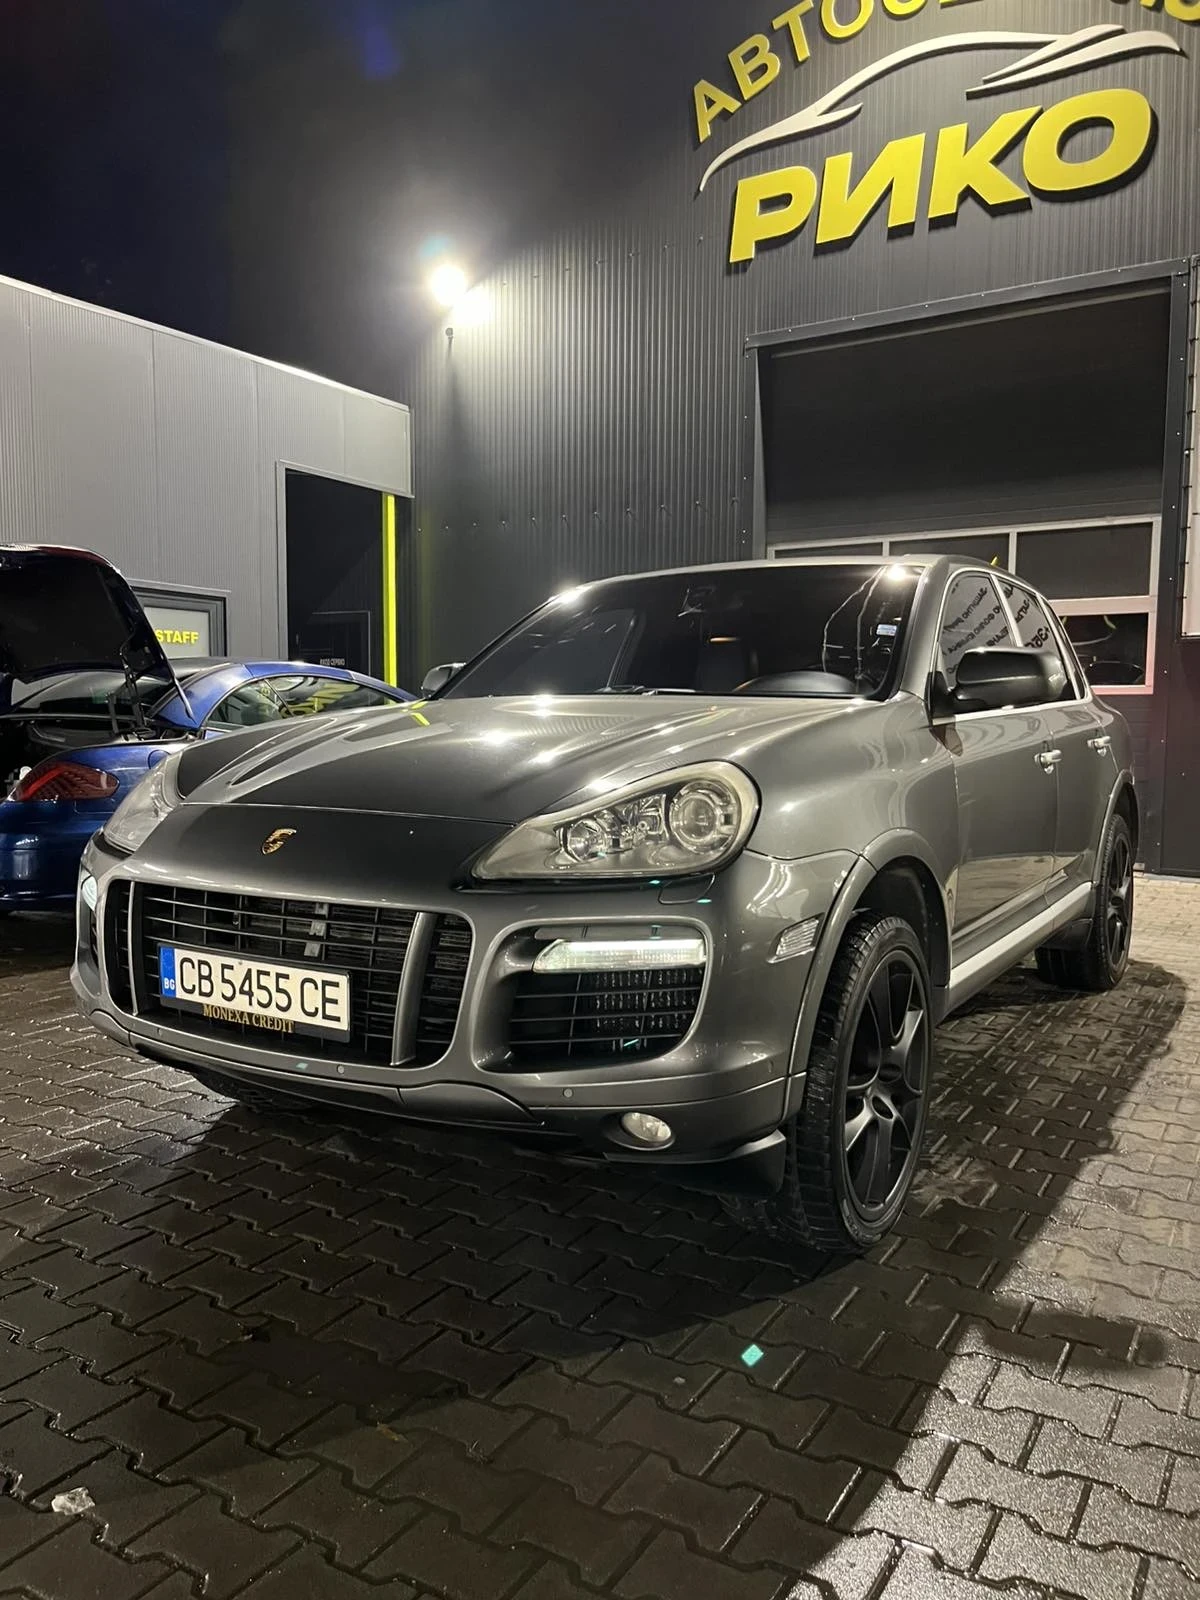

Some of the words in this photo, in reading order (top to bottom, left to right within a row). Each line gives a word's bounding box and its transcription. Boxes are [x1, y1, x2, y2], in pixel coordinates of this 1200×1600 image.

[729, 88, 1152, 263] РИКО
[155, 629, 199, 645] STAFF
[164, 977, 176, 990] BG
[179, 956, 214, 998] CB
[220, 964, 292, 1013] 5455
[300, 977, 341, 1022] CE
[203, 1004, 249, 1024] MONEXA
[252, 1014, 294, 1033] CREDIT
